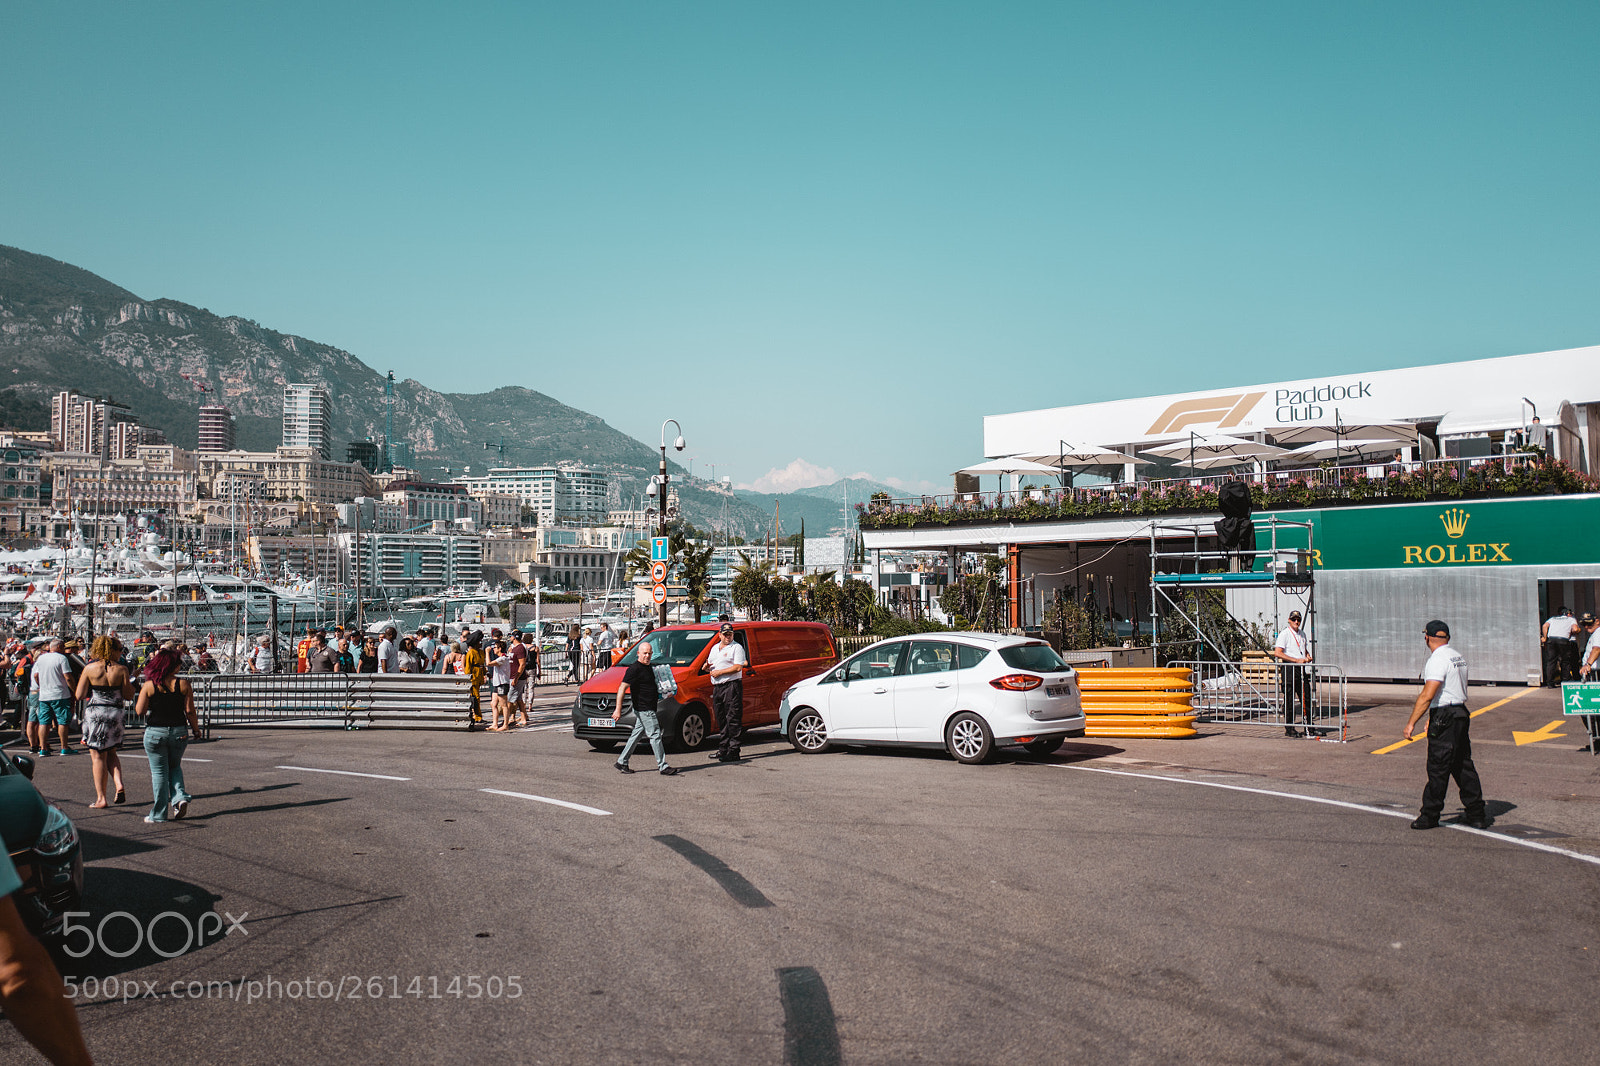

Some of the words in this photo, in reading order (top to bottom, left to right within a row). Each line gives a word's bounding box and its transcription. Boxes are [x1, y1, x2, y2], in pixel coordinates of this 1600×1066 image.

[1275, 381, 1372, 406] Paddock
[1275, 404, 1323, 423] Club
[1402, 543, 1513, 564] ROLEX
